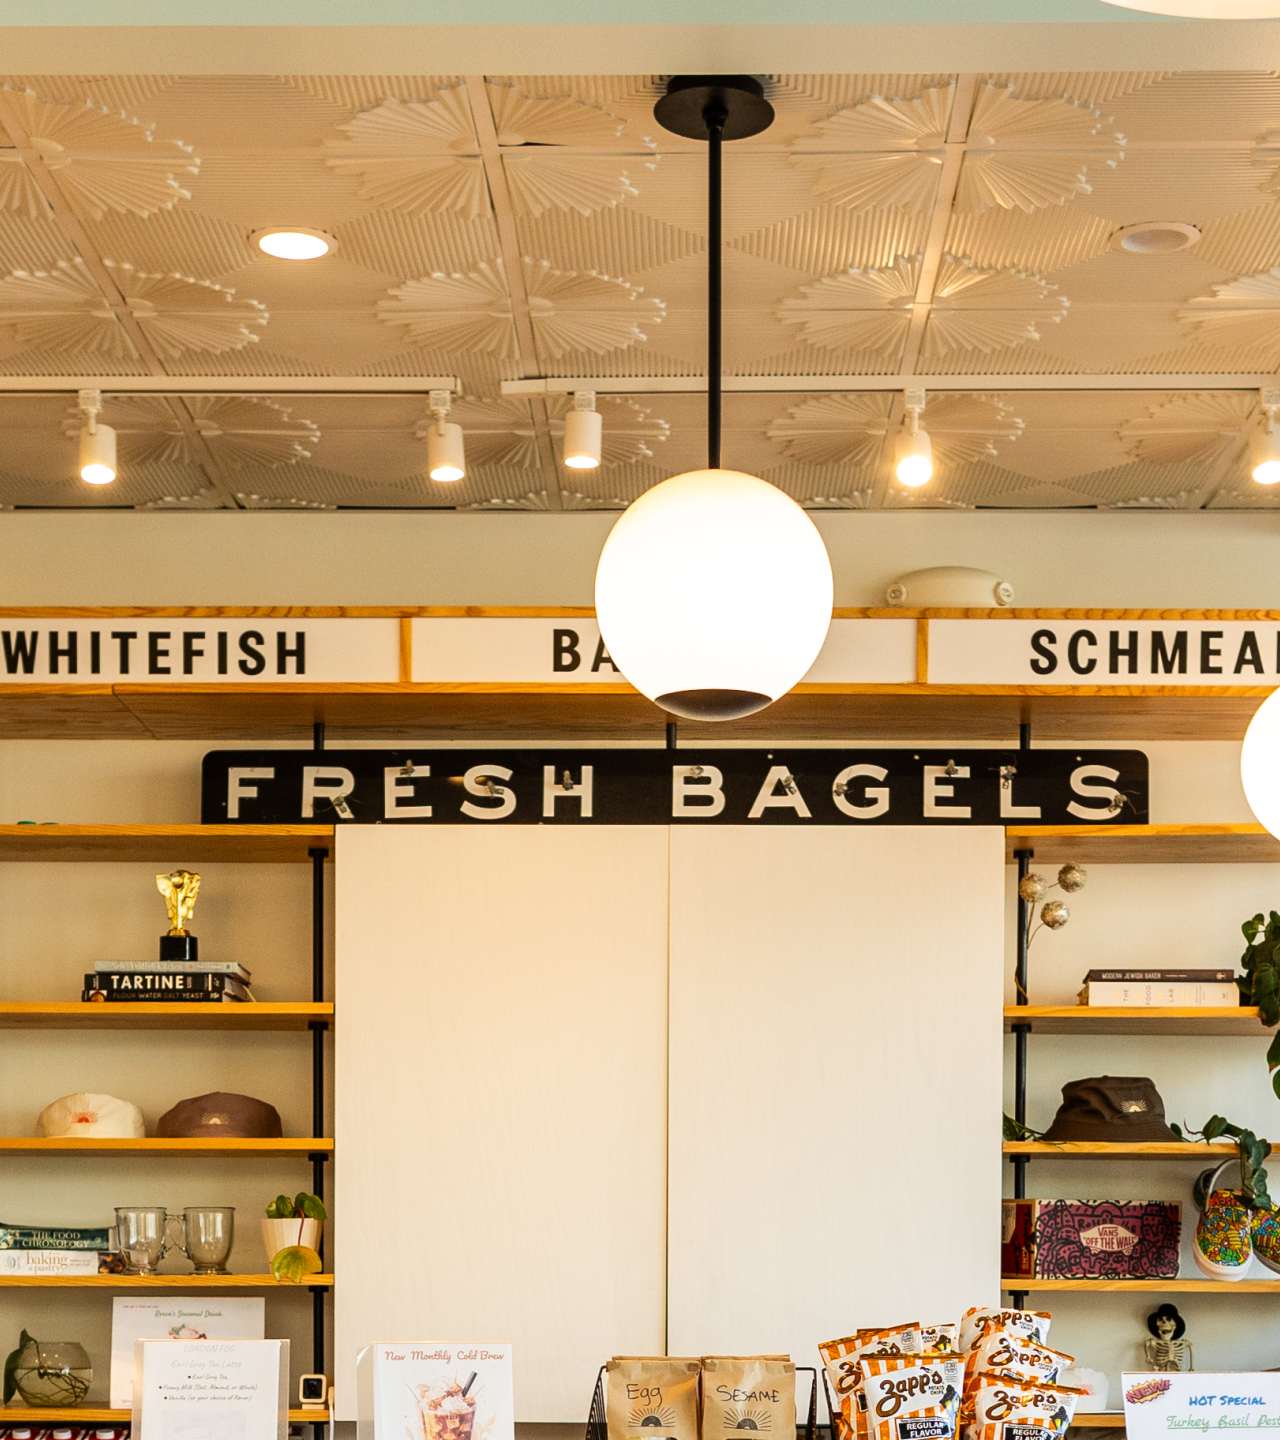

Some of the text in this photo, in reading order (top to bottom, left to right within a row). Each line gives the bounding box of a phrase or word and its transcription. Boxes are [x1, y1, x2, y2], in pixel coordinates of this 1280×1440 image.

[1, 630, 308, 676] WHITEFISH
[226, 763, 1125, 820] FRESH BAGELS
[111, 975, 184, 989] TARTINE
[31, 1231, 81, 1240] THE FOOD
[1097, 1227, 1119, 1237] VANS
[22, 1239, 90, 1249] CHRONOLOGY
[1100, 1237, 1116, 1249] THE
[410, 1350, 452, 1364] Monthly
[457, 1350, 478, 1360] Cold
[480, 1350, 505, 1360] Brew
[626, 1383, 663, 1407] Egg
[716, 1384, 781, 1403] SESAME
[1189, 1395, 1266, 1406] HOT SPECIAL
[906, 1421, 945, 1431] REGULAR
[1166, 1414, 1210, 1432] Turkey
[1219, 1413, 1249, 1428] Basil
[910, 1429, 943, 1438] FLAVOR
